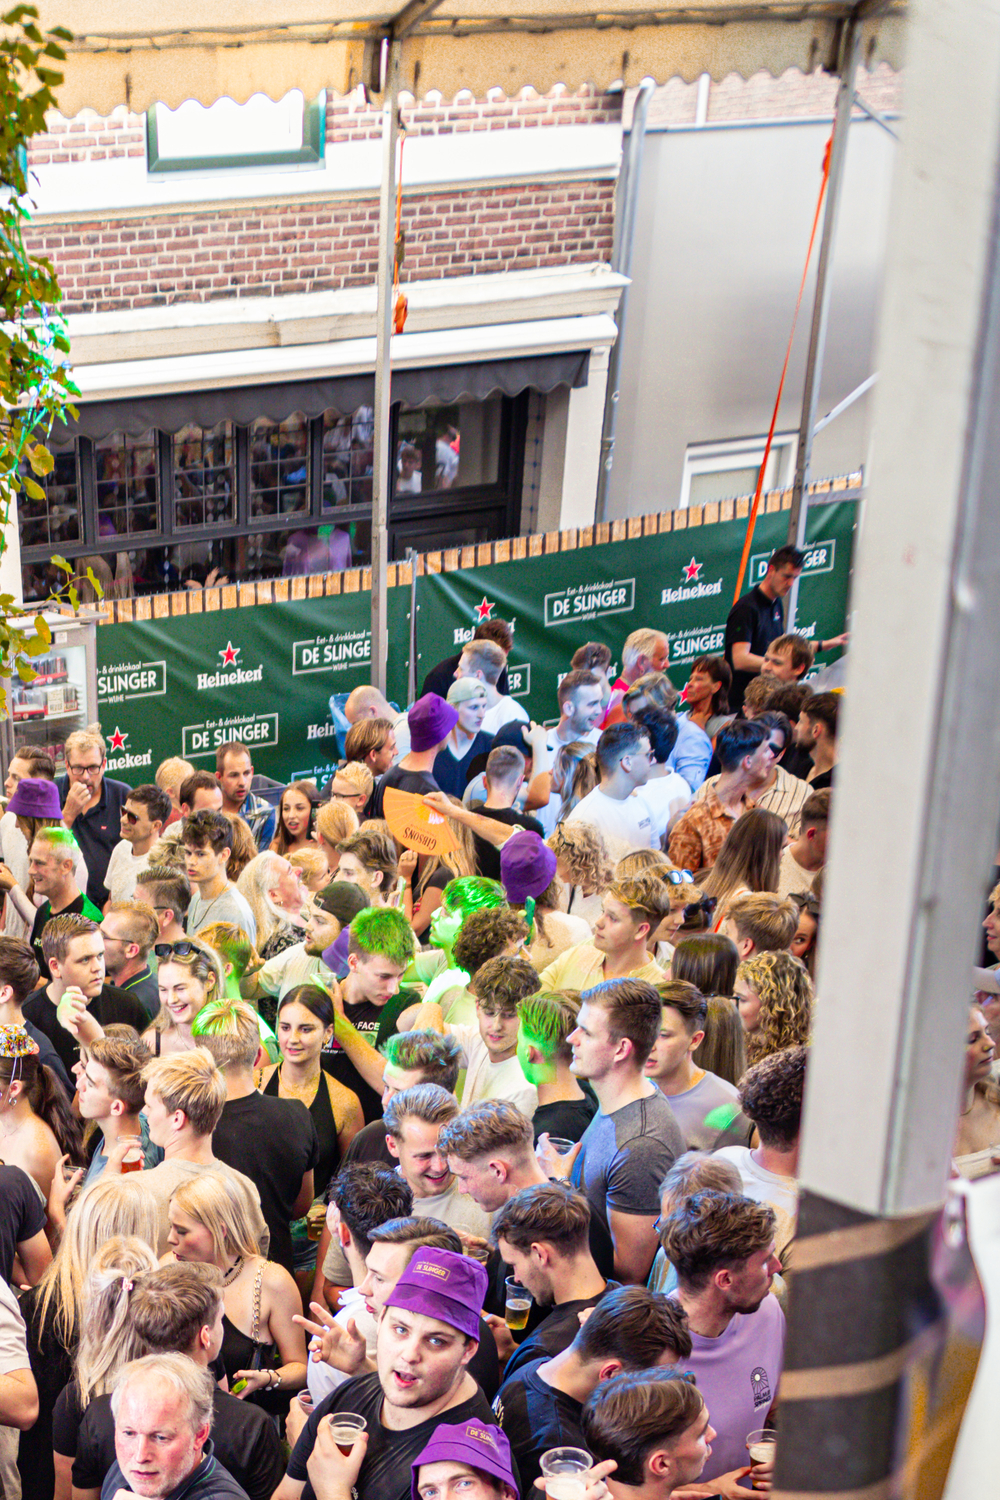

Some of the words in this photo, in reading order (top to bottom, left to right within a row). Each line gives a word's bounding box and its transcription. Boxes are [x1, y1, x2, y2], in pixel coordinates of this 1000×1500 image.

[578, 584, 584, 594] &
[660, 581, 722, 606] Heineken
[553, 599, 570, 617] DE
[573, 588, 627, 614] SLINGER
[329, 634, 334, 643] &
[335, 630, 366, 643] drinklokaal
[672, 632, 725, 658] SLINGER
[302, 647, 320, 666] DE
[323, 640, 371, 664] SLINGE
[108, 661, 142, 675] drinklokaal
[197, 666, 263, 691] Heineken
[98, 670, 157, 695] SLINGER
[218, 716, 224, 726] &
[224, 713, 256, 726] drinklokaal
[307, 721, 336, 740] Hein
[192, 732, 210, 750] DE
[213, 722, 270, 747] SLINGER
[403, 826, 438, 851] GIBSONS
[357, 1021, 381, 1031] FACE
